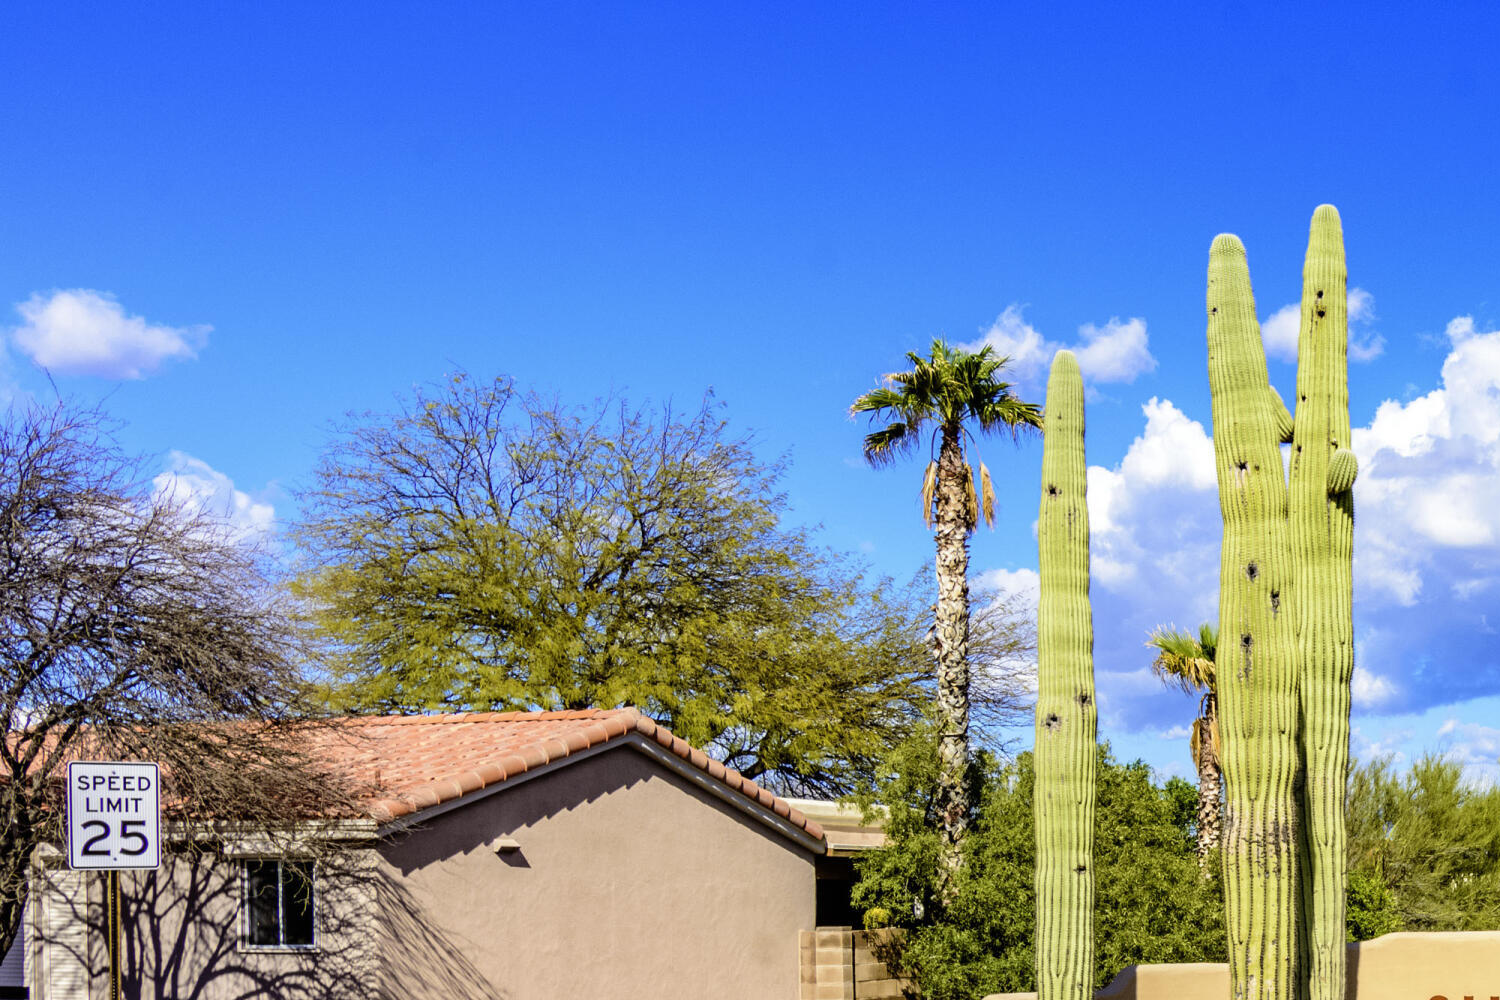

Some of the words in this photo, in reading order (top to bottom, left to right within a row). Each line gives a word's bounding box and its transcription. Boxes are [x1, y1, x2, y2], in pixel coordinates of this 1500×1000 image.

[77, 775, 151, 791] SPEED
[86, 797, 143, 812] LIMIT
[81, 820, 149, 856] 25
